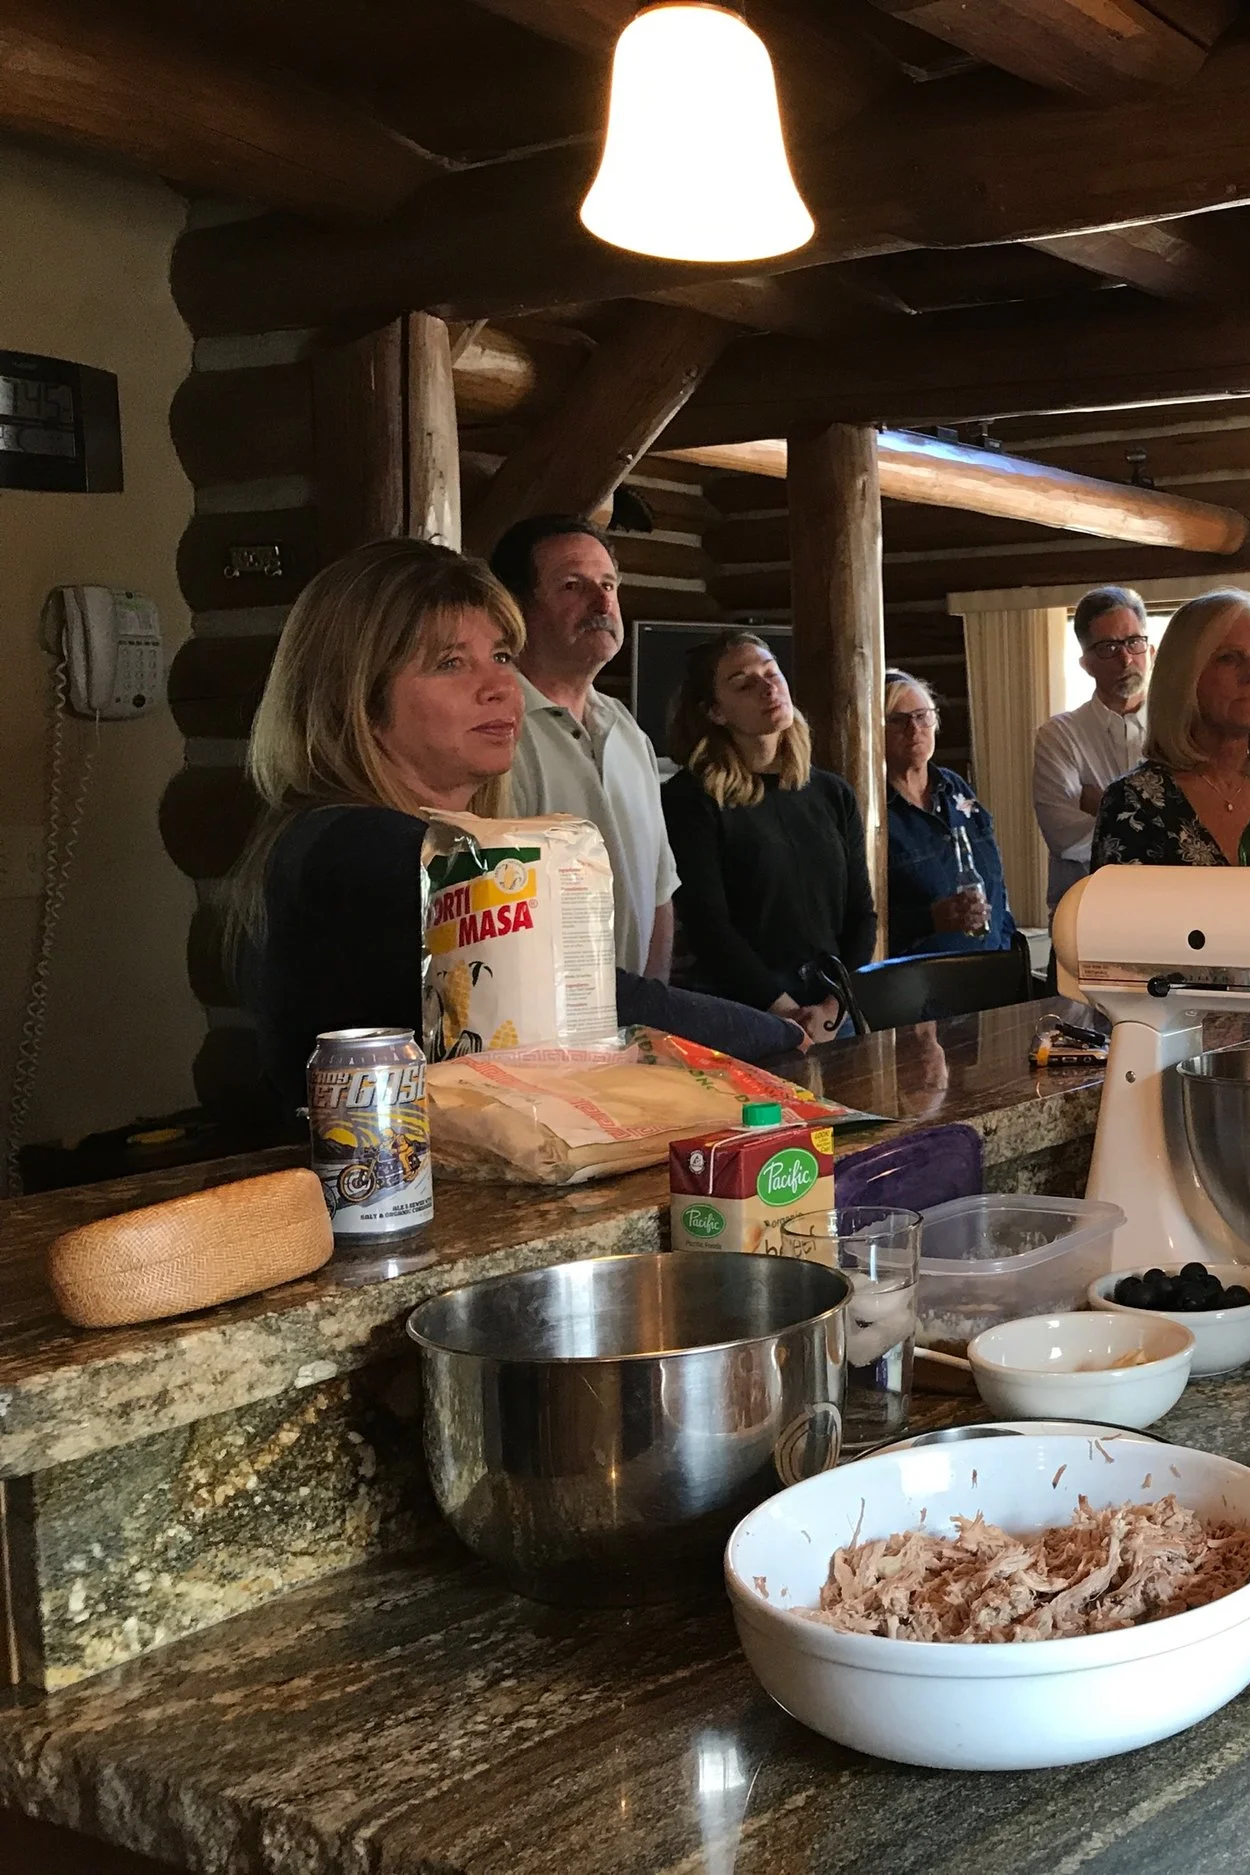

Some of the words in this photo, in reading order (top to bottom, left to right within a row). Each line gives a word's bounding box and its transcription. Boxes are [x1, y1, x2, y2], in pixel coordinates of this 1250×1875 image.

[459, 901, 533, 947] MASA
[313, 1085, 348, 1108] ET
[763, 1159, 810, 1194] Pacific
[685, 1209, 719, 1234] Pacific
